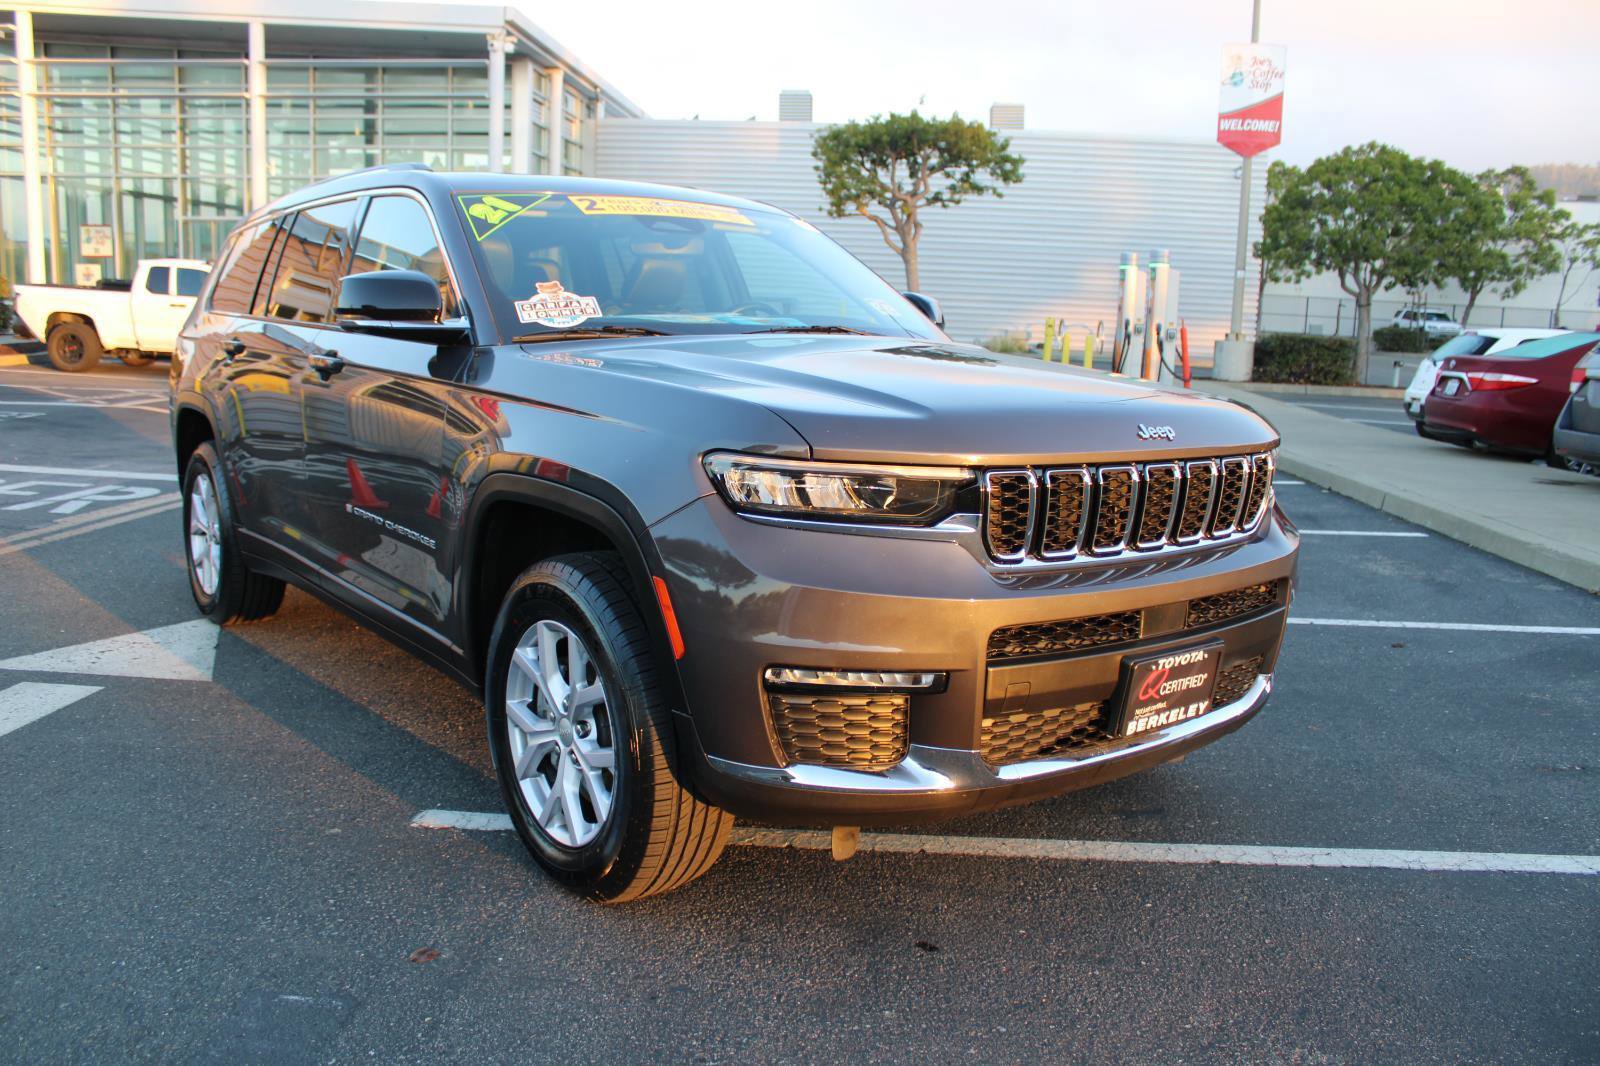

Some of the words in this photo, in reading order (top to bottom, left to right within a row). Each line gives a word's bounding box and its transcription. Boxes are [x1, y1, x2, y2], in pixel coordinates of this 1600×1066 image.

[1250, 67, 1285, 81] Coffee
[1248, 80, 1272, 93] Stop
[1219, 118, 1281, 133] WELCOME!
[576, 198, 605, 211] 2
[1137, 423, 1176, 442] Jeep
[384, 520, 437, 550] CHEROKEE
[1157, 651, 1205, 671] TOYOTA
[1126, 701, 1210, 736] BERKELEY
